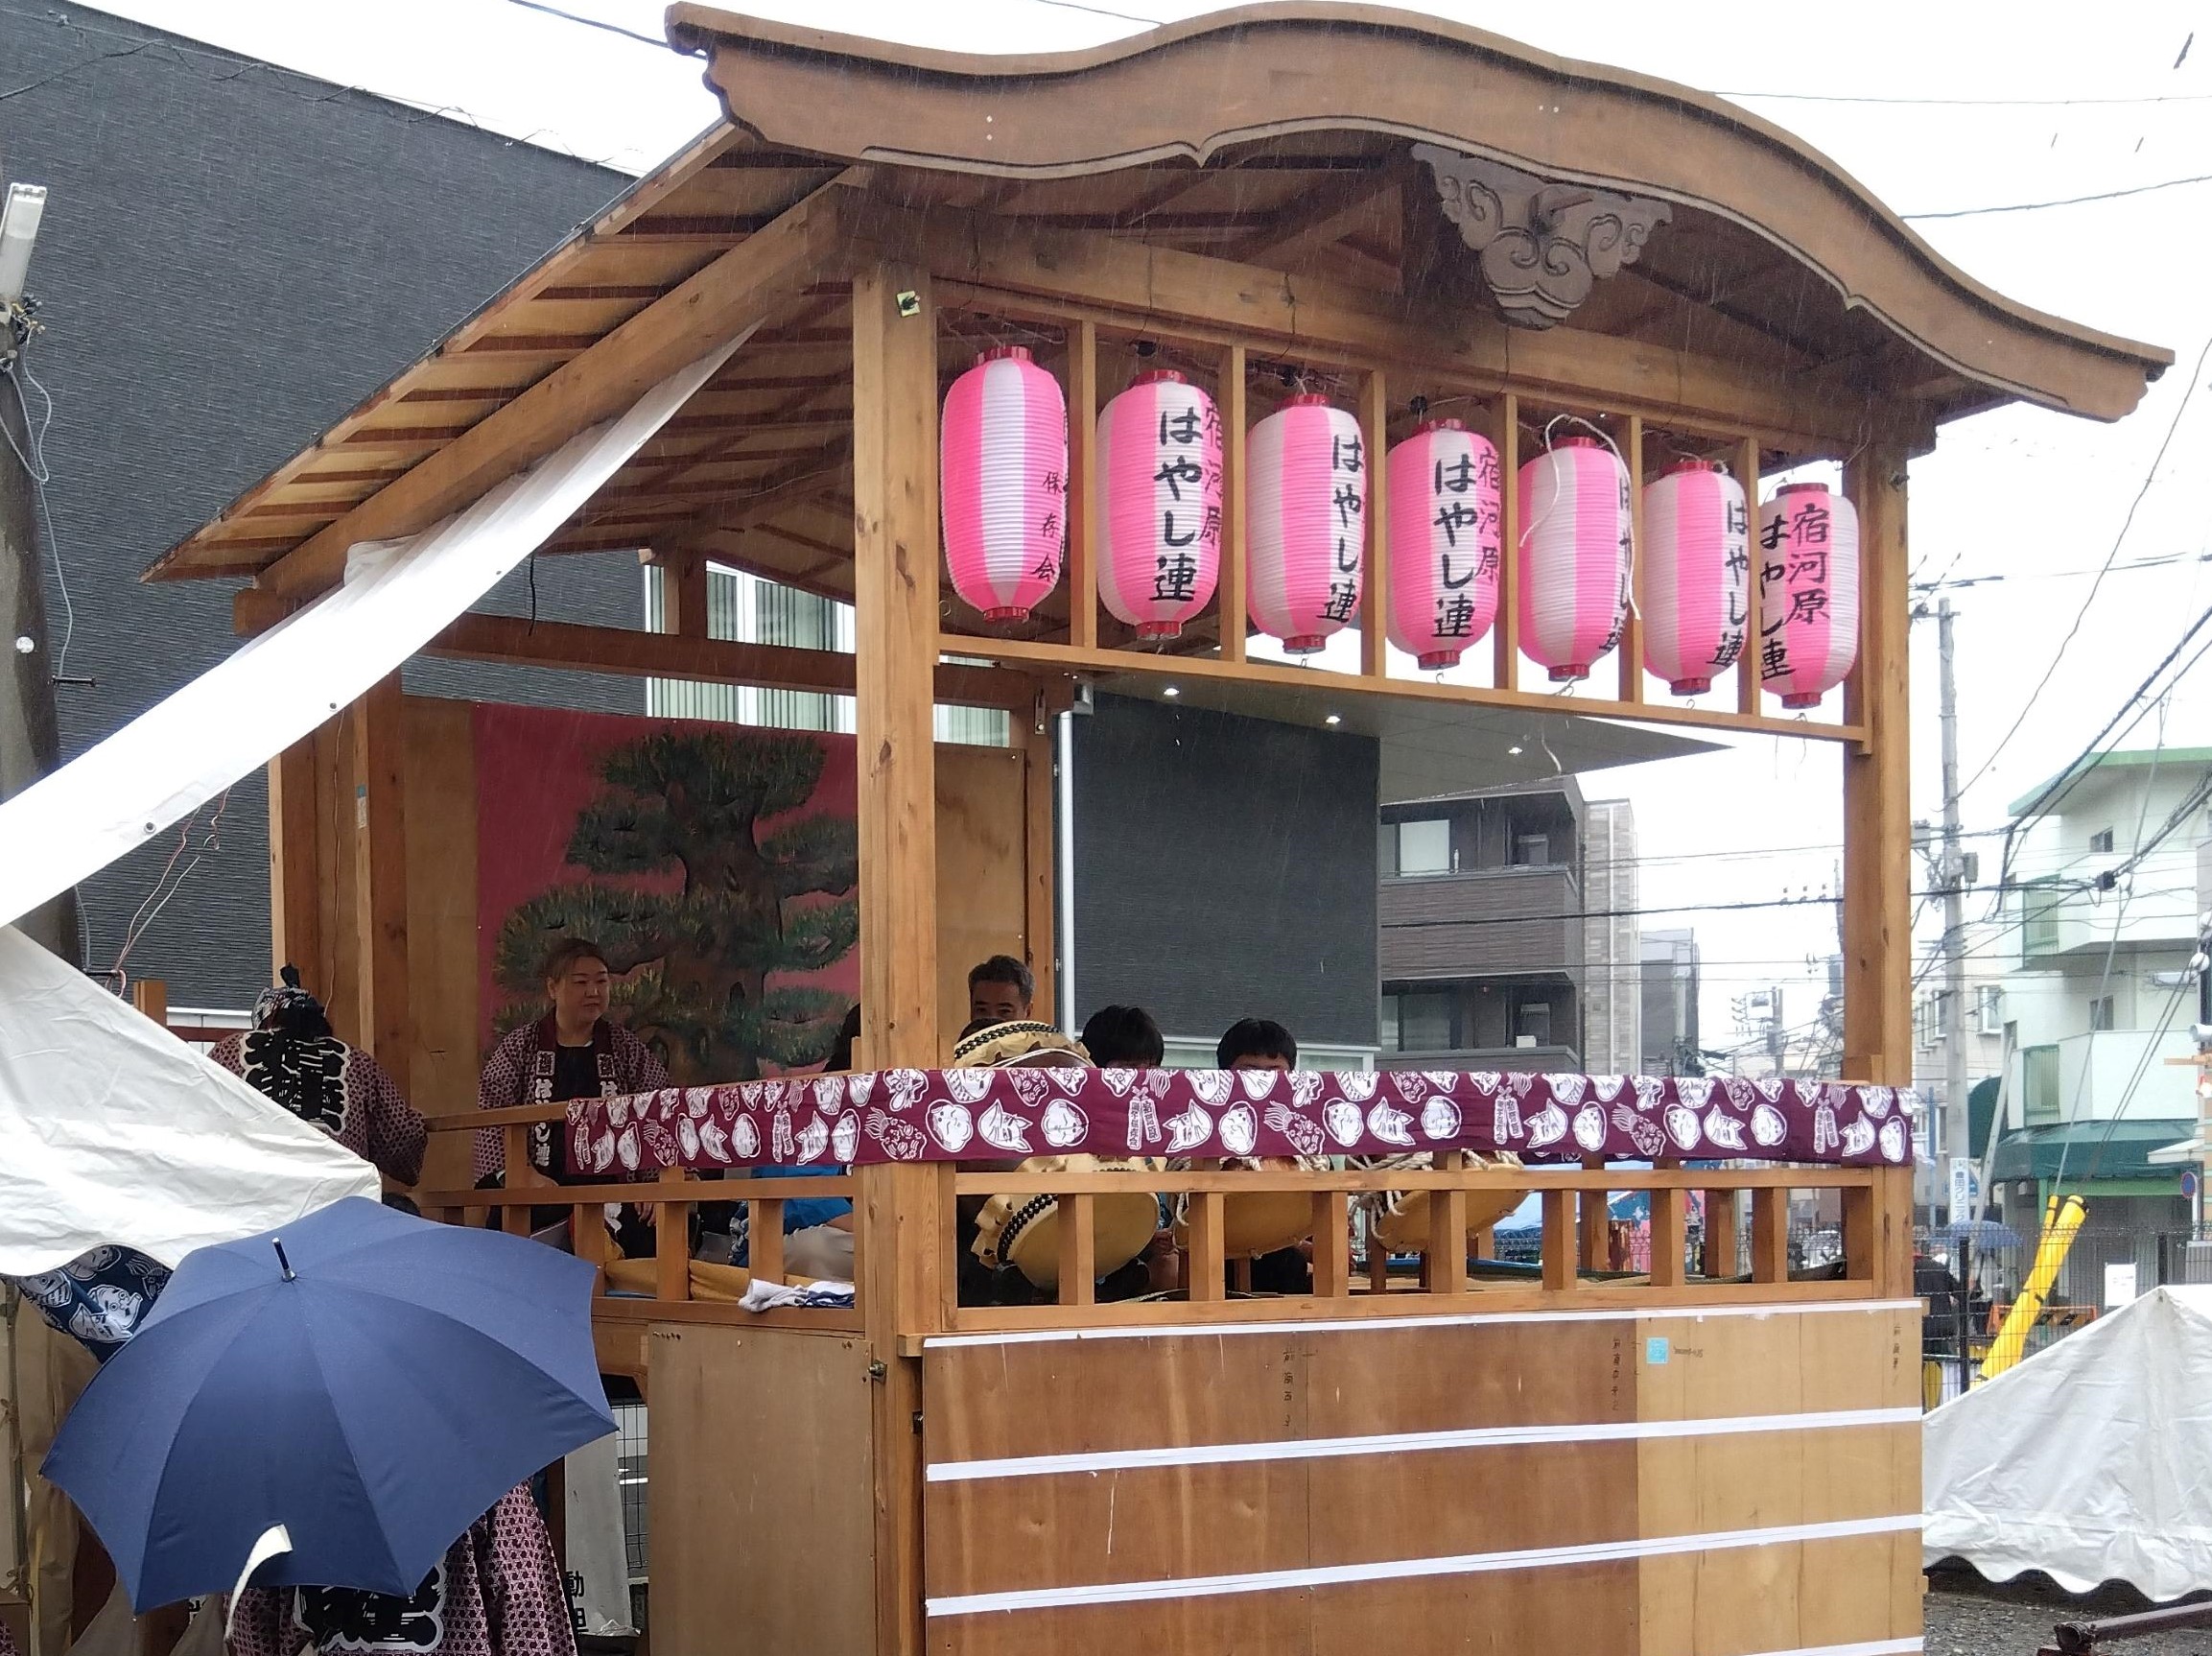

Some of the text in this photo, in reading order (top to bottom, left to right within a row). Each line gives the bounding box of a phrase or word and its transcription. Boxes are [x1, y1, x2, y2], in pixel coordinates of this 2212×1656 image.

[1149, 407, 1203, 602] はやし連
[1316, 435, 1364, 623] はやし連
[1431, 453, 1477, 637] はやし連
[1706, 500, 1748, 666] はやし連
[1783, 503, 1830, 625] 宿河原
